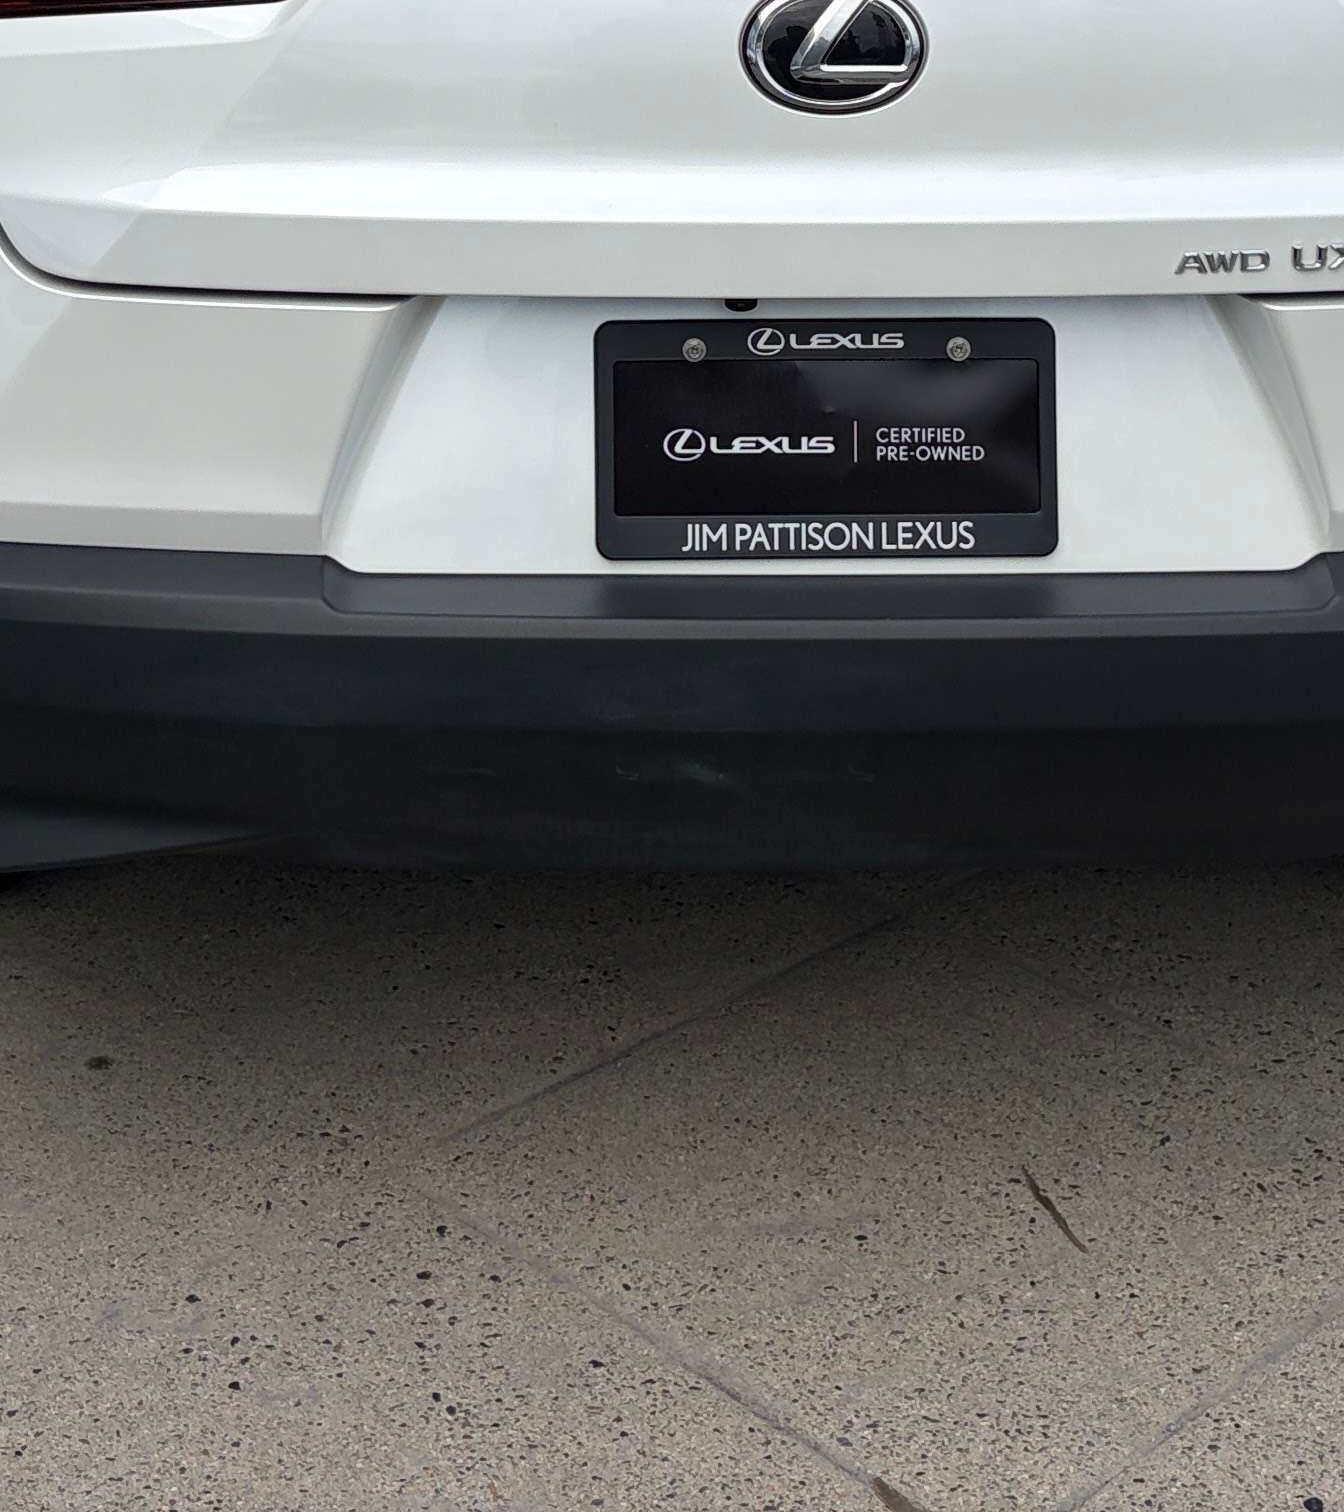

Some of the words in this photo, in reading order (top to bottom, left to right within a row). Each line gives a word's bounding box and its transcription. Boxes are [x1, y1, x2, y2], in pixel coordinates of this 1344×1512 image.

[1174, 249, 1270, 275] AWD
[789, 333, 905, 349] LEXUS
[710, 436, 836, 454] LEXUS
[875, 427, 966, 444] CERTIFIED
[875, 445, 985, 461] PRE-OWNED
[681, 522, 728, 552] JIM
[734, 521, 874, 551] PATTISON
[881, 520, 976, 551] LEXUS
